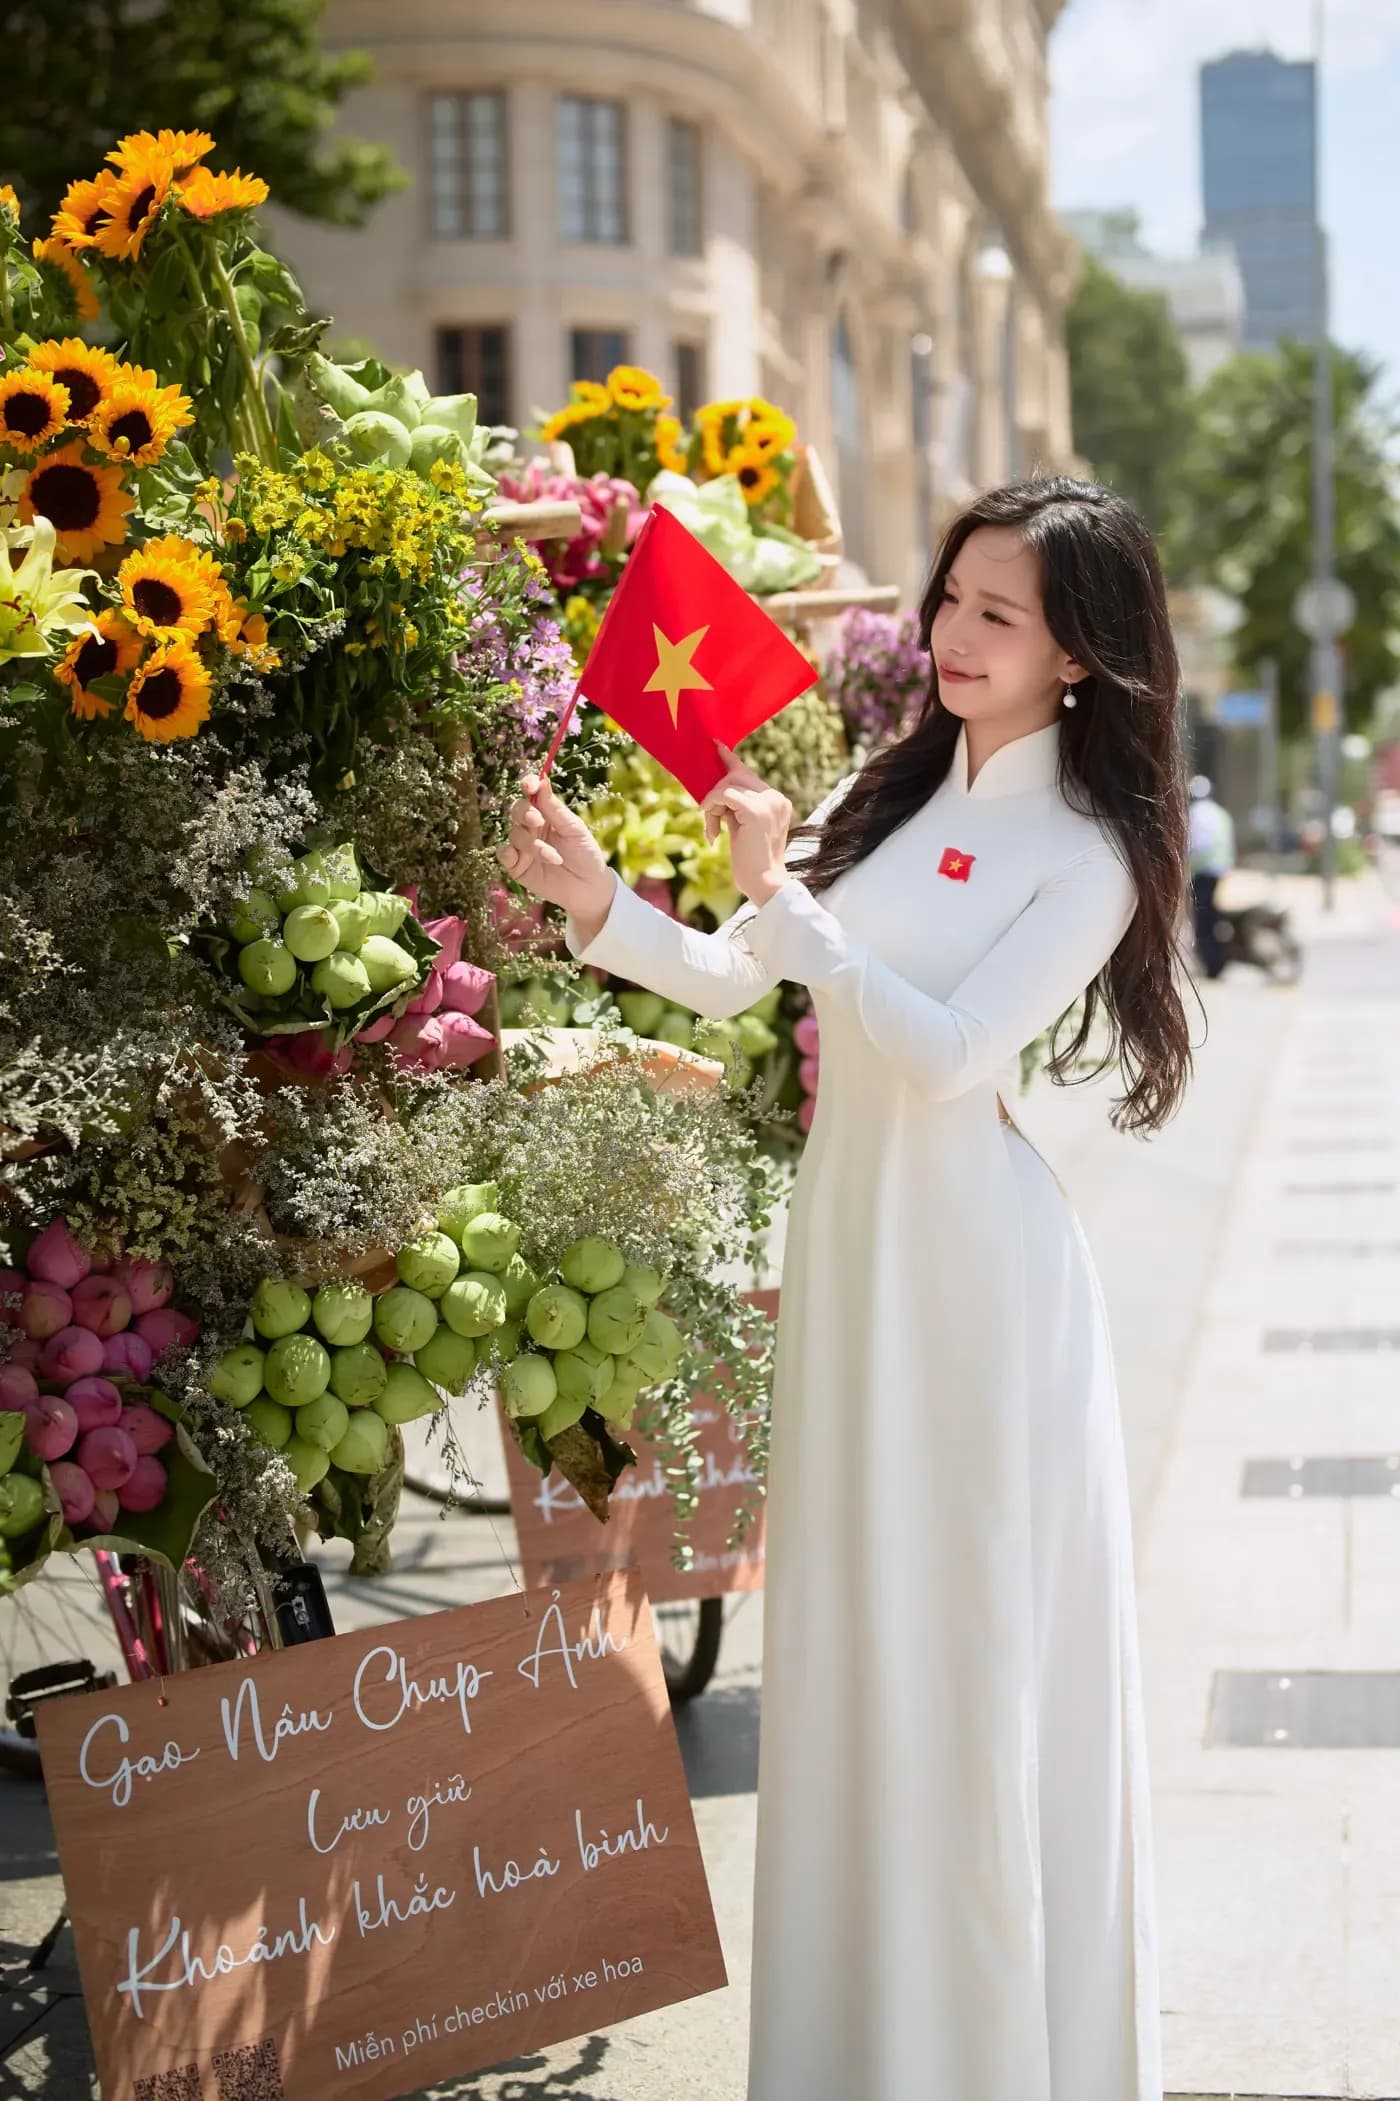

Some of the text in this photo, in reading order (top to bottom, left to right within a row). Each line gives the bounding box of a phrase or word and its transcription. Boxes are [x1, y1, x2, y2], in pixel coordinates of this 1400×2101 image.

[80, 1590, 627, 1806] Gạo Nâu Chụp Ảnh
[307, 1774, 472, 1853] Lưu giữ
[117, 1799, 668, 2018] Khoảnh khắc hoà bình
[335, 1956, 644, 2070] Miễn phí checkin với xe hoa
